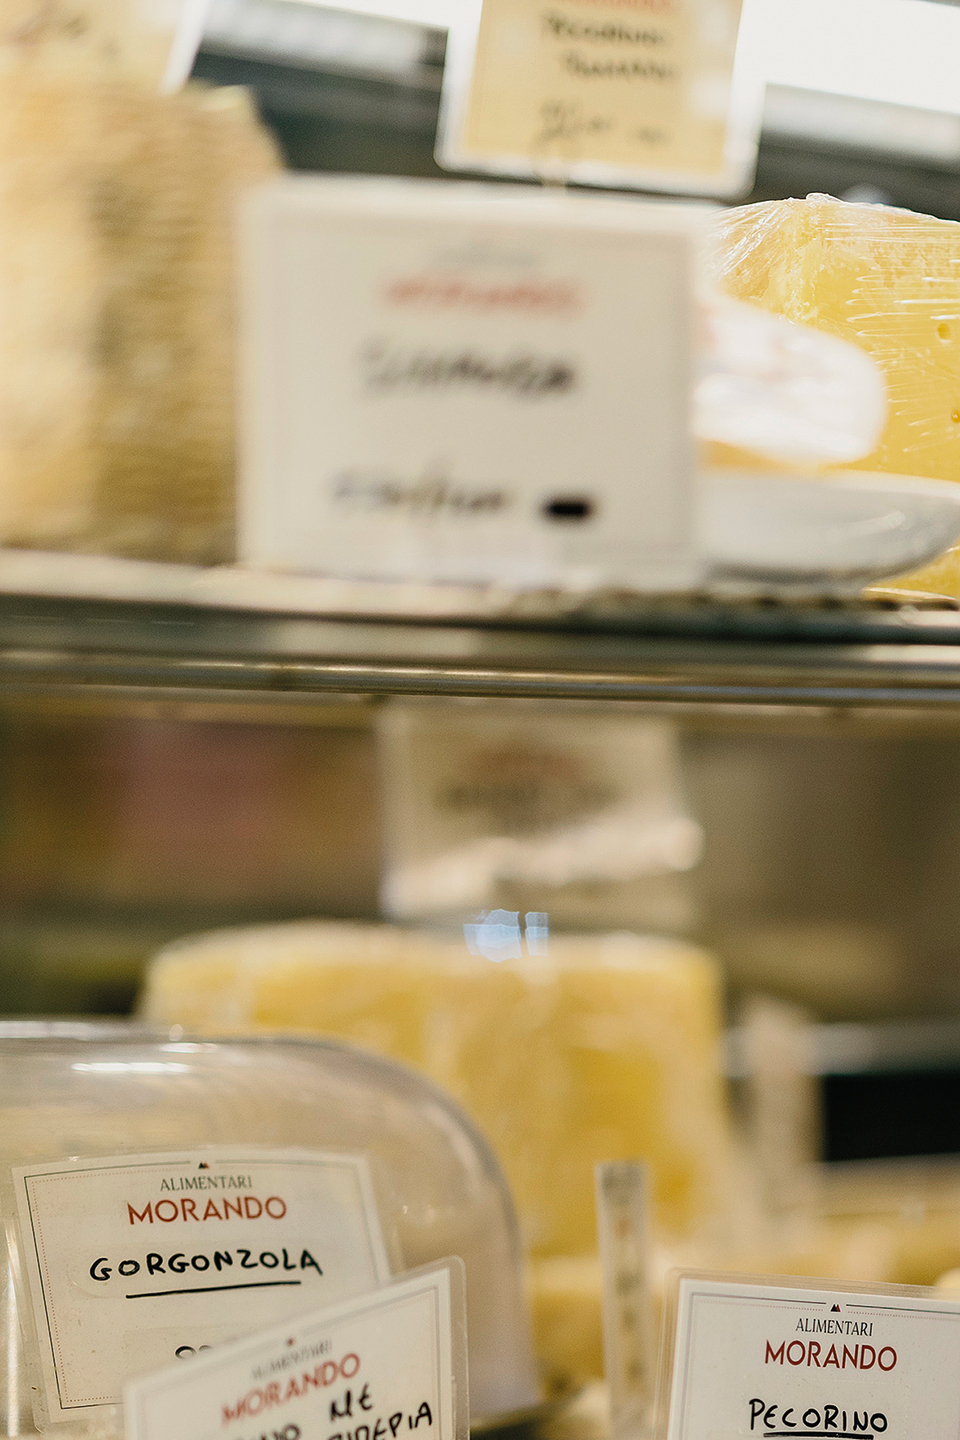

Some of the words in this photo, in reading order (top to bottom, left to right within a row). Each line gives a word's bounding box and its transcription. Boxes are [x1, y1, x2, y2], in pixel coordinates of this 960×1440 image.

[159, 1175, 253, 1192] ALIMENTARI
[126, 1196, 288, 1225] MORANDO
[89, 1248, 323, 1282] GORGONZOLA
[795, 1318, 874, 1337] ALIMENTARI
[764, 1339, 898, 1372] MORANDO
[219, 1353, 361, 1428] MORANDO
[749, 1397, 889, 1433] PECORINO
